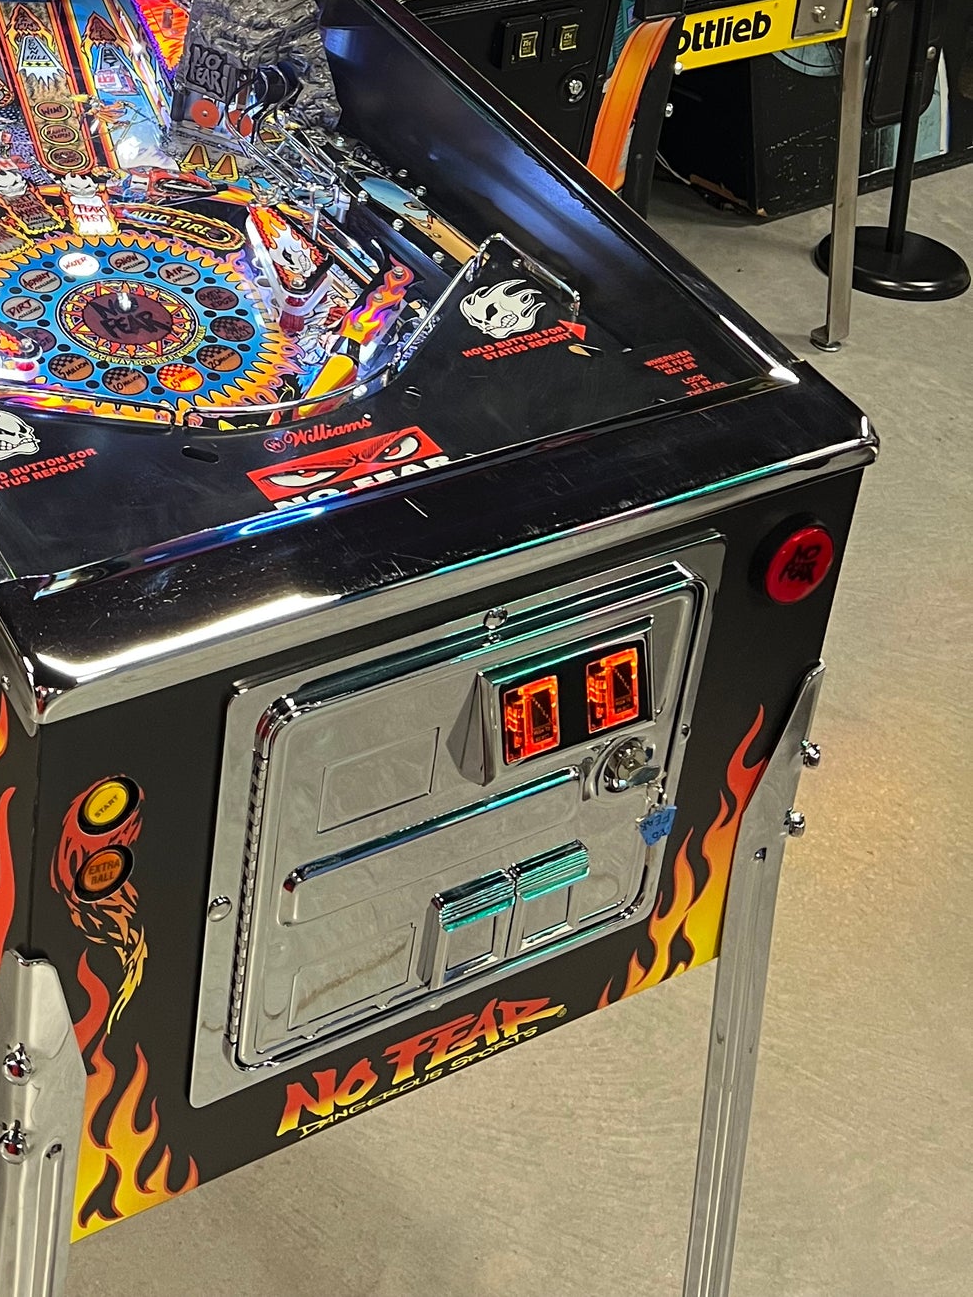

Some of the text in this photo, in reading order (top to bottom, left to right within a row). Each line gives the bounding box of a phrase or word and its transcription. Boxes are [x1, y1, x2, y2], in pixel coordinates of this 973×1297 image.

[462, 325, 567, 358] HOLD BUTTON FOR
[482, 331, 573, 361] STATUS REPORT
[643, 350, 692, 367] WHEREVER
[681, 374, 707, 385] LOOK
[284, 413, 373, 448] Williams
[10, 456, 67, 477] BUTTON
[68, 448, 98, 461] FOR
[32, 460, 86, 480] REPORT
[94, 794, 119, 819] START
[89, 859, 120, 875] EXTRA
[91, 871, 115, 886] BALL
[276, 997, 565, 1138] NO FEAR
[297, 1026, 539, 1139] DANGEROUS SPORTS
